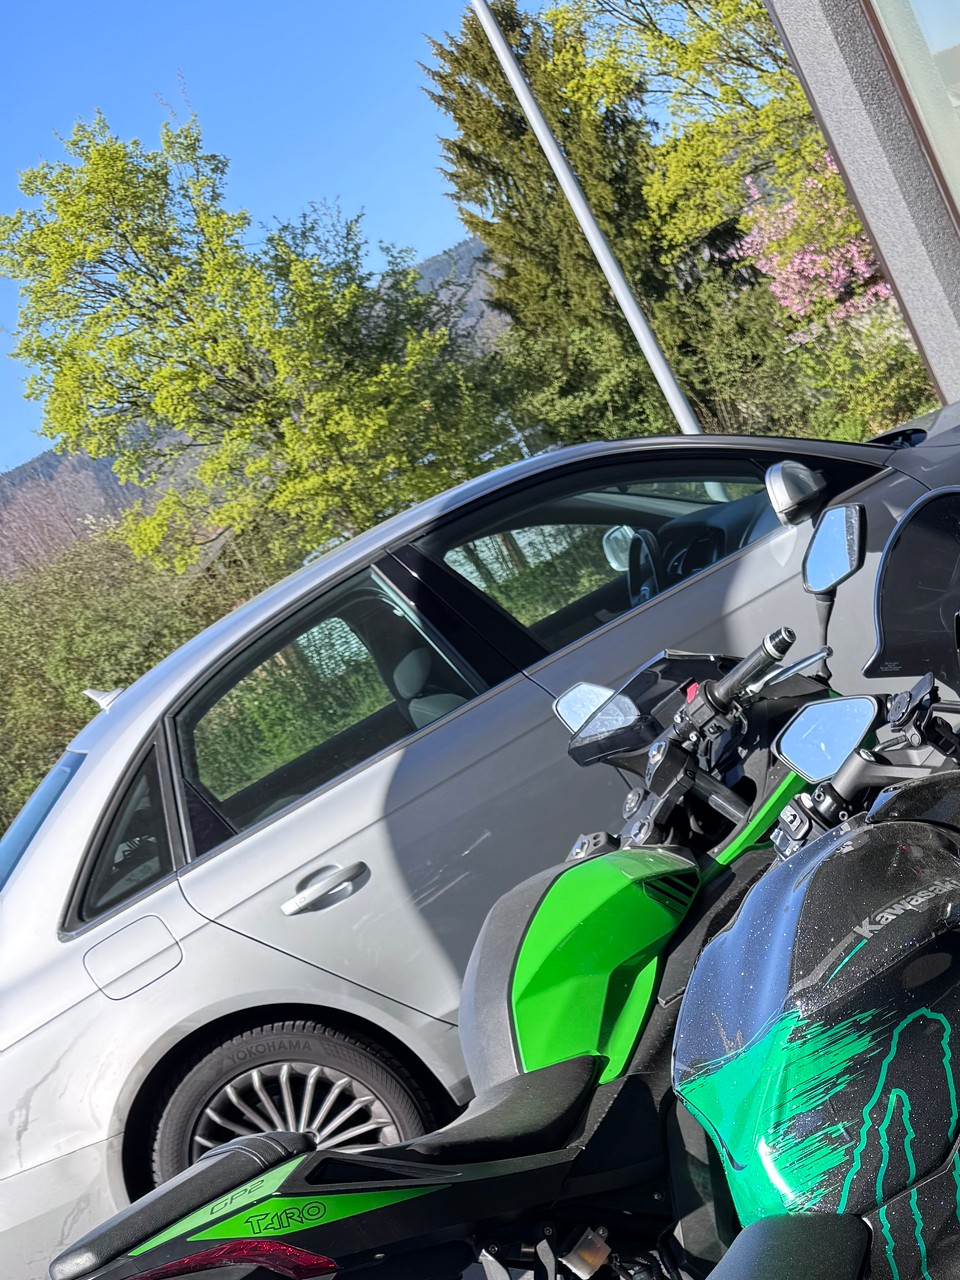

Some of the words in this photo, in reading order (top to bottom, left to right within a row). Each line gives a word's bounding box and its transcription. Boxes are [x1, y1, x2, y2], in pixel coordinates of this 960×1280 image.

[227, 1040, 312, 1064] YOKOHAMA
[210, 1179, 265, 1215] GP2
[244, 1201, 326, 1235] TARO
